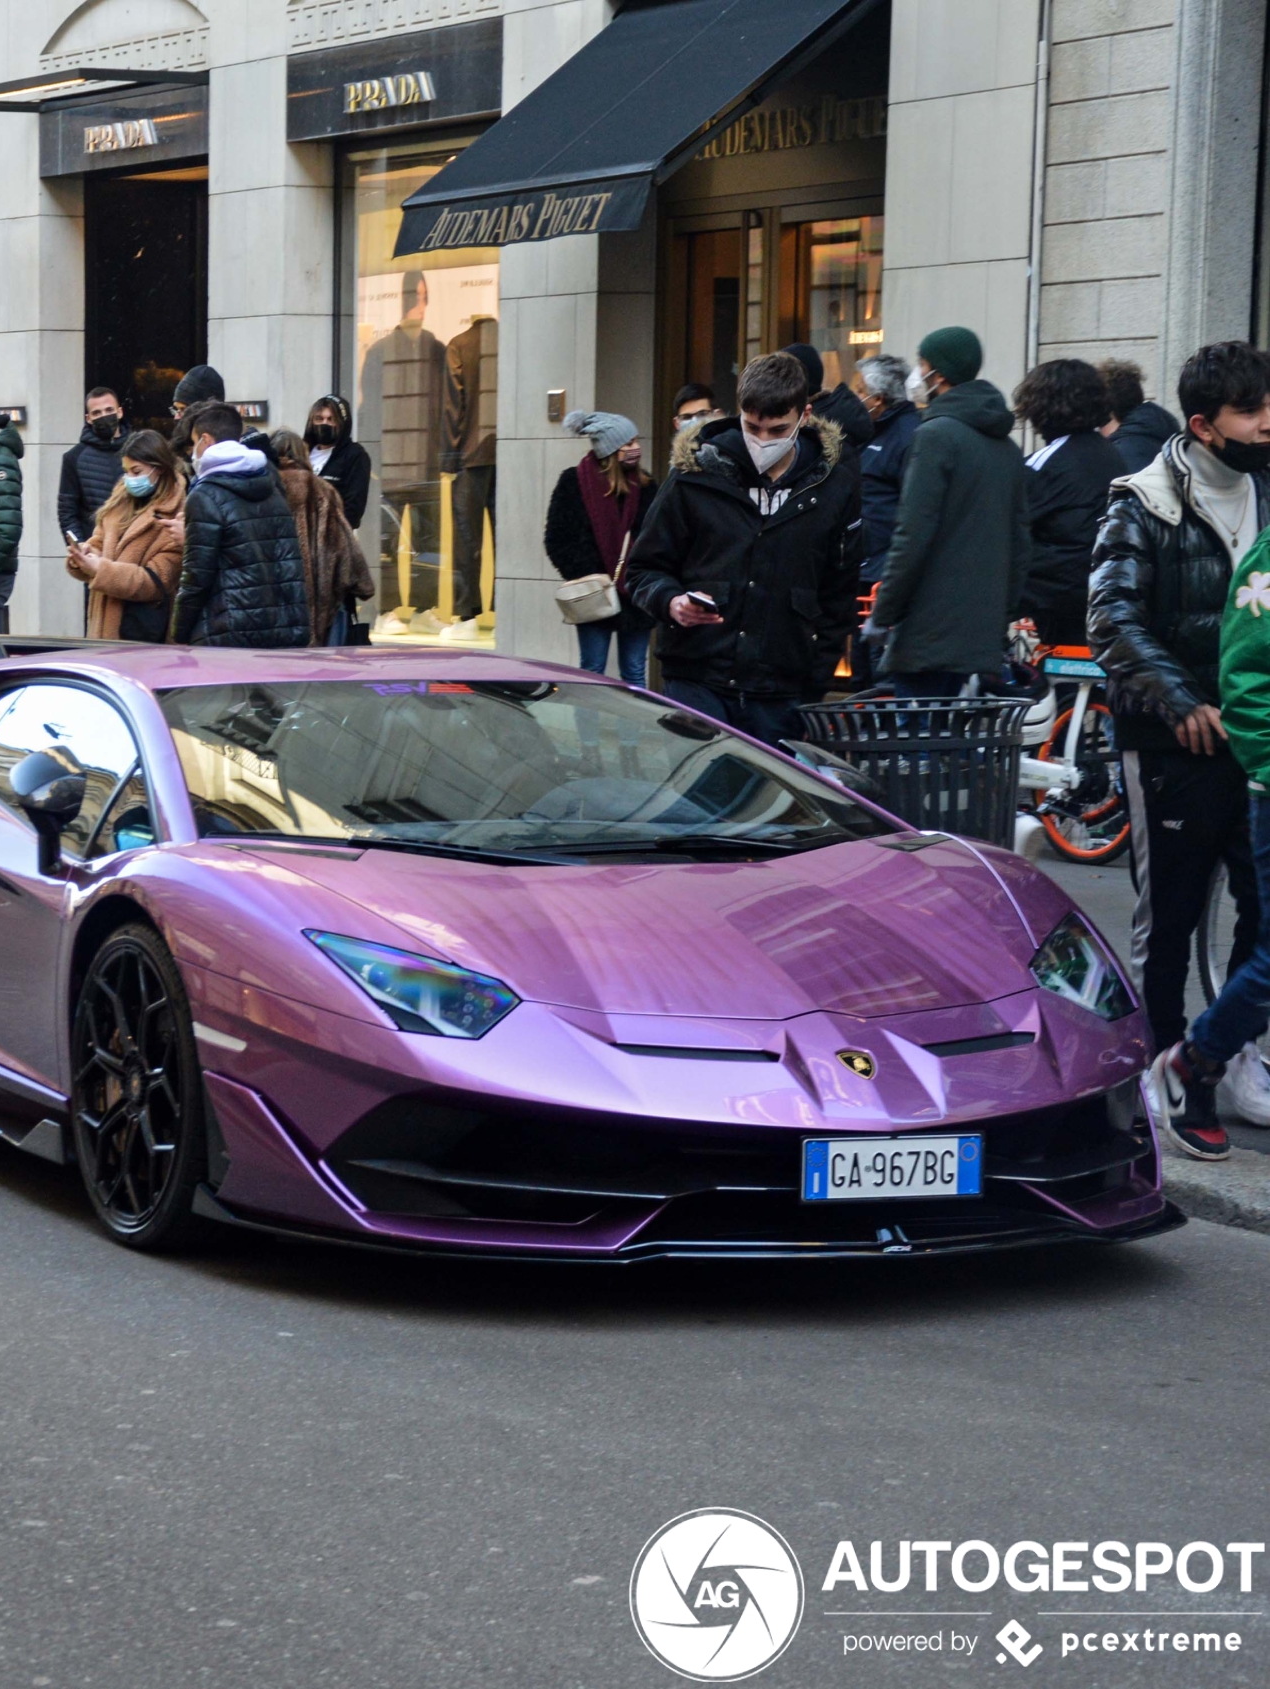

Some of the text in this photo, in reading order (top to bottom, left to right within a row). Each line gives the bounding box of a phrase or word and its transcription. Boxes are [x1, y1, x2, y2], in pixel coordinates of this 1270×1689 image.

[343, 71, 436, 114] PRADA
[84, 118, 157, 153] PRADA
[419, 192, 612, 249] AUDEMARS PIGUET
